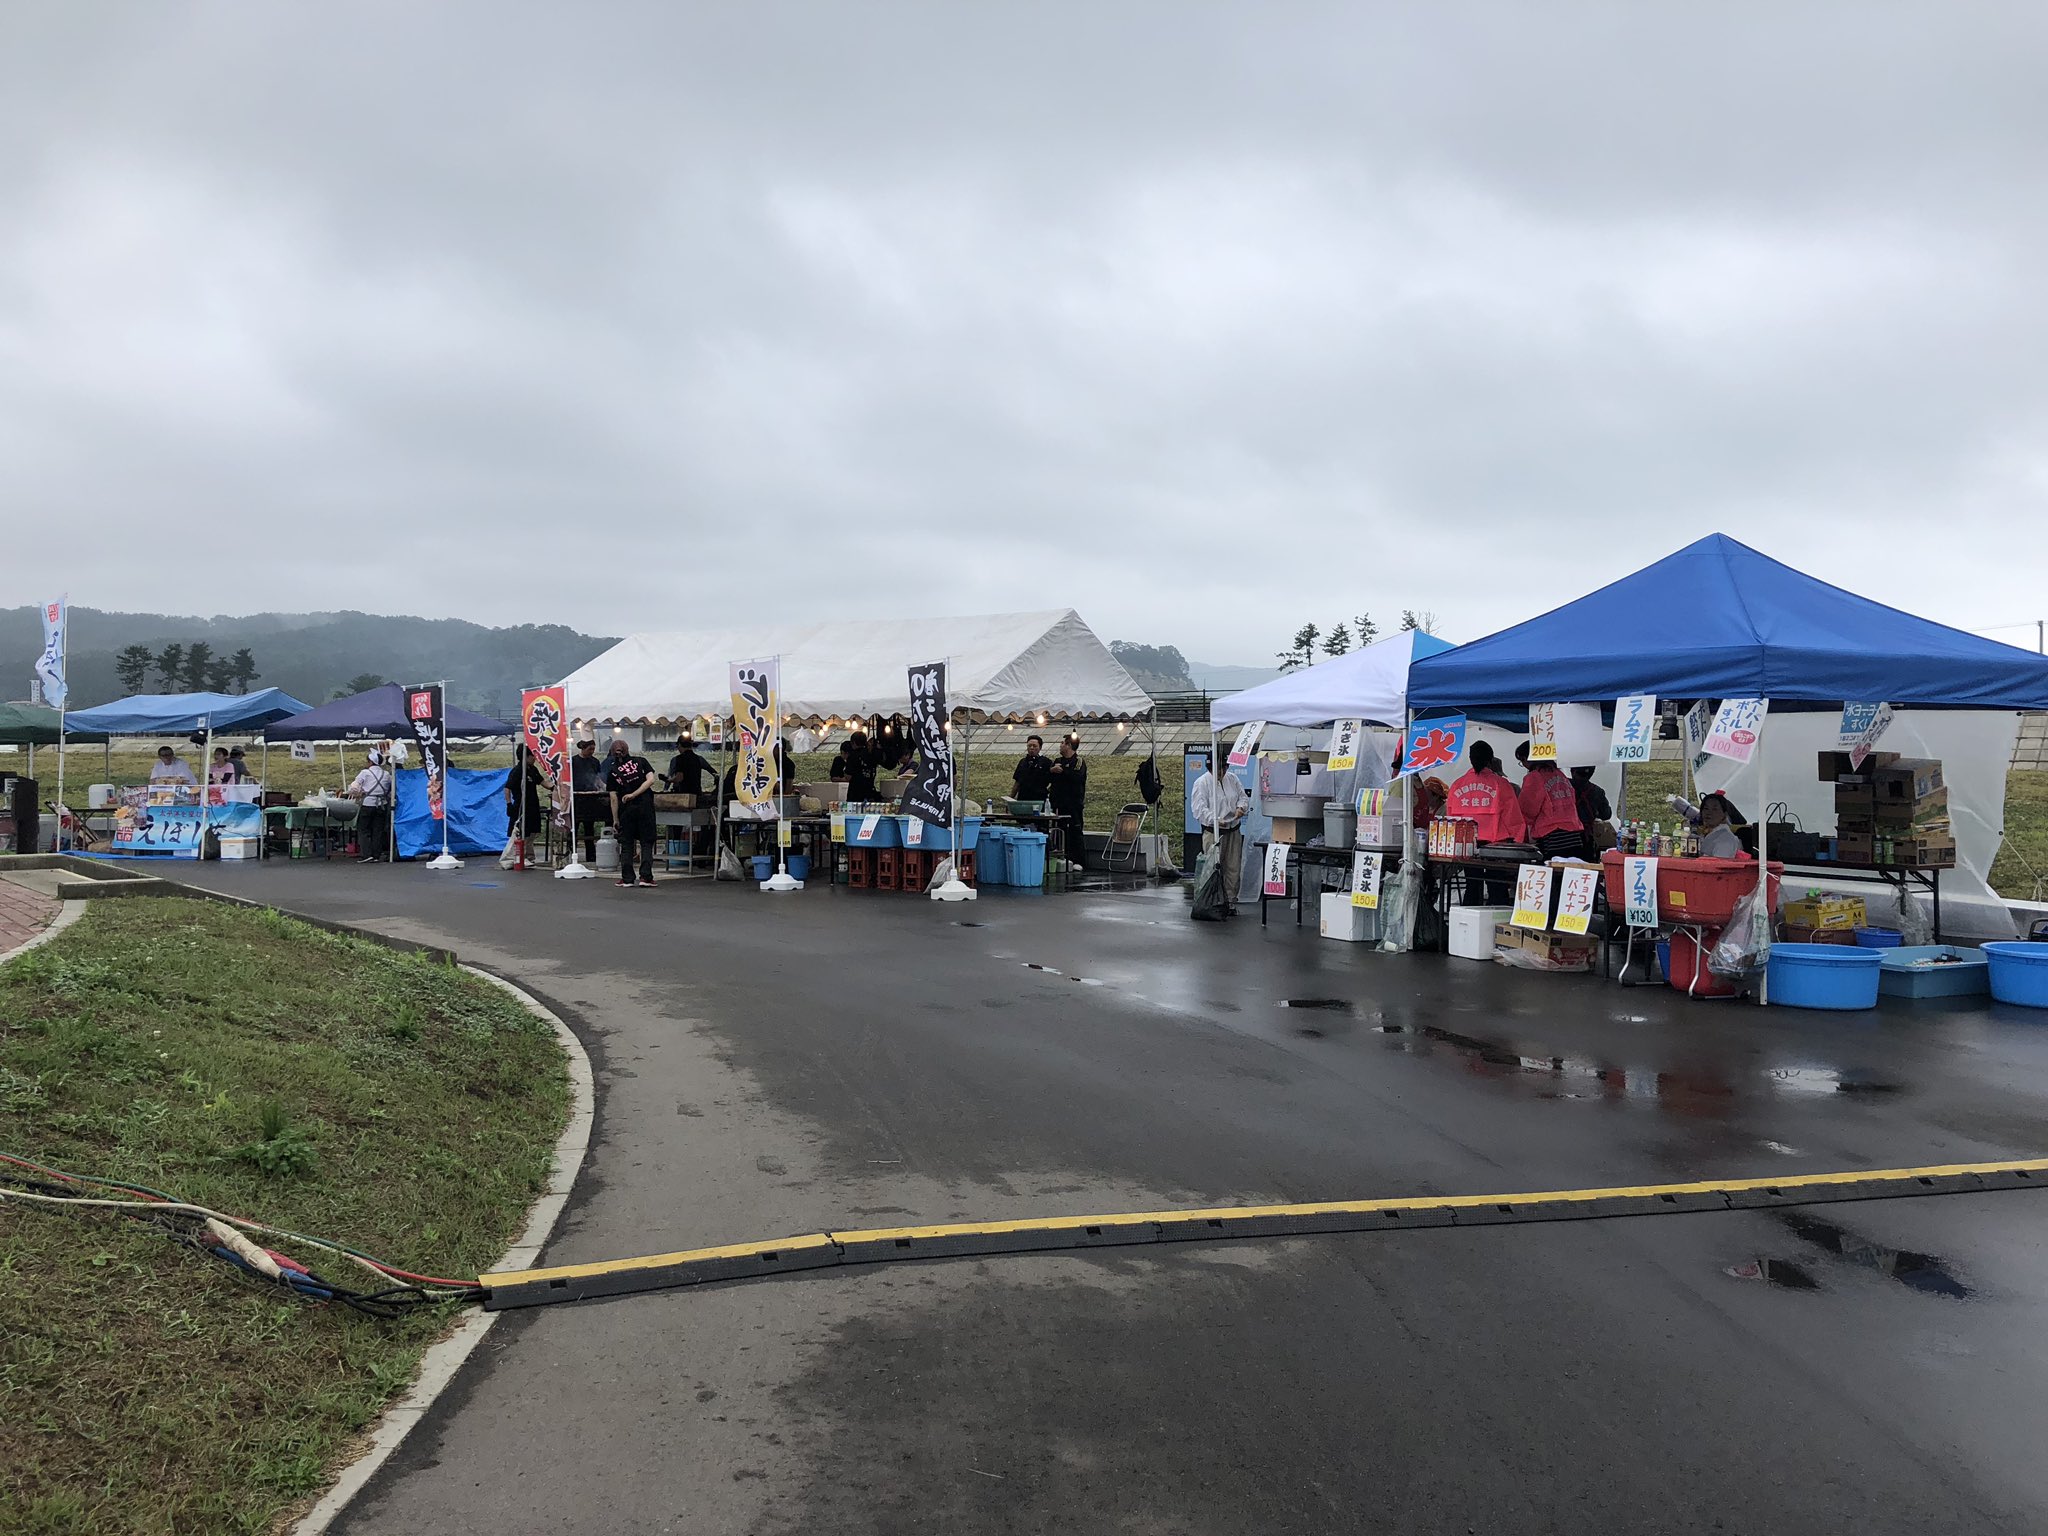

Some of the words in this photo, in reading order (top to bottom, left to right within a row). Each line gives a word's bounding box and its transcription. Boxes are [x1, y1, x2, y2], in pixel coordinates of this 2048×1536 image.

[1624, 699, 1642, 742] ラムネ
[1715, 708, 1733, 733] すくい
[1729, 701, 1750, 728] ボール
[1846, 704, 1880, 716] 水ヨーヨ
[1238, 722, 1257, 753] わたあめ
[1338, 721, 1352, 756] かき氷
[1405, 728, 1457, 768] 氷
[1616, 746, 1643, 758] ¥130
[1271, 847, 1281, 882] わたあめ
[1360, 855, 1374, 893] かき氷
[1524, 869, 1535, 901] フルト
[1534, 870, 1547, 910] フランク
[1565, 879, 1578, 912] バナナ
[1578, 874, 1591, 904] チョコ
[1634, 860, 1647, 906] ラムネ
[1630, 910, 1653, 923] ¥130
